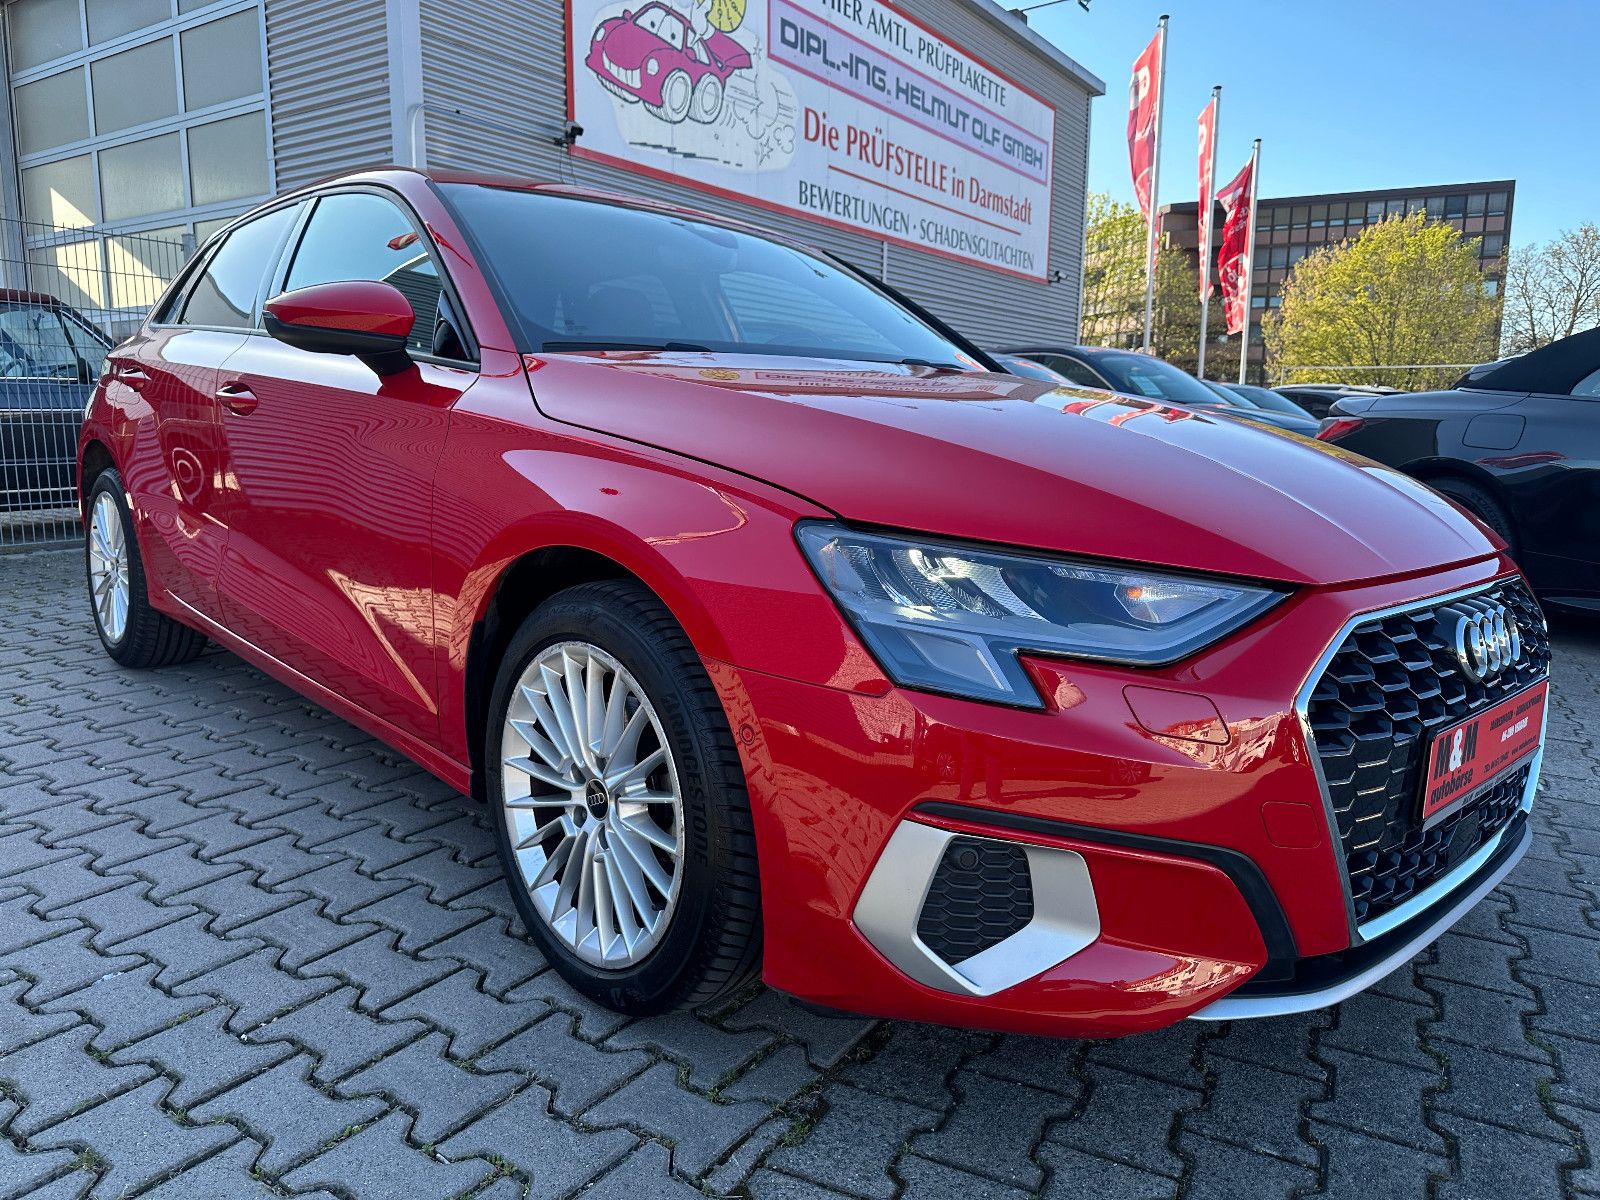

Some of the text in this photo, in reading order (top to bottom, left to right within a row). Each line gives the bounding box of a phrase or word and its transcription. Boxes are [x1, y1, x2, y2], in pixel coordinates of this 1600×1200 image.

[780, 16, 892, 96] DIPL.-ING.
[895, 77, 970, 133] HELMUT
[972, 117, 1002, 147] OLF
[867, 8, 914, 54] AMTL.
[918, 36, 1007, 107] PRÜFPLAKETTE
[803, 106, 1032, 225] Die PRÜFSTELLE in Darmstadt
[799, 179, 1034, 271] BEWERTUNGEN SCHADENSGUTACHTEN
[1430, 767, 1474, 807] autobörse
[1433, 720, 1480, 781] M&M
